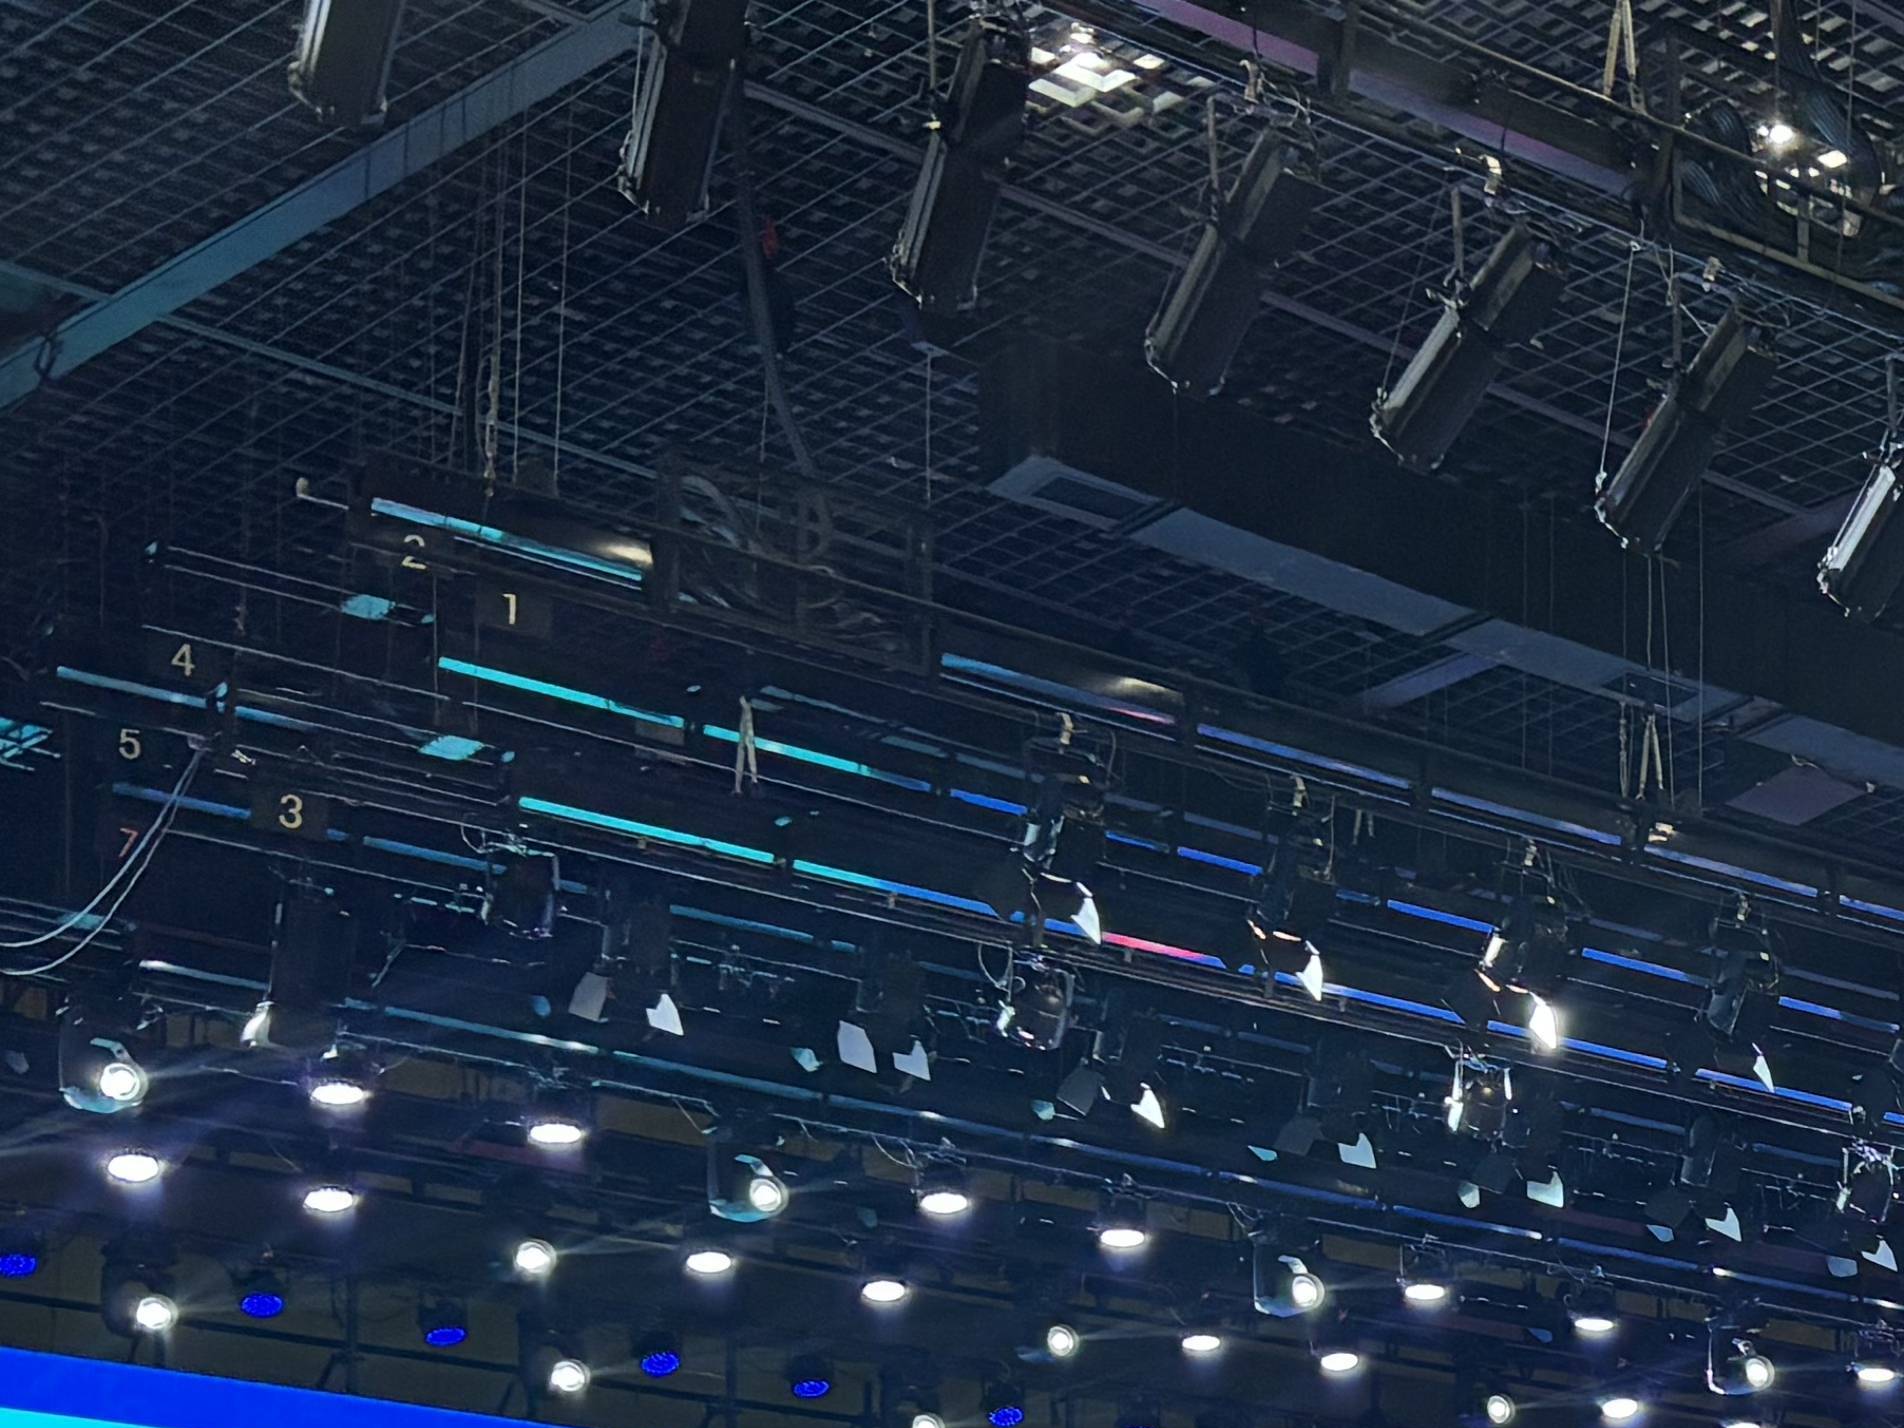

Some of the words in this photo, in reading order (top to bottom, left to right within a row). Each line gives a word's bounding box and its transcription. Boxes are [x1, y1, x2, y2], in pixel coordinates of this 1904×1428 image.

[402, 534, 428, 570] 2
[502, 593, 518, 626] 1
[171, 643, 196, 677] 4
[119, 728, 142, 760] 5
[278, 793, 304, 829] 3
